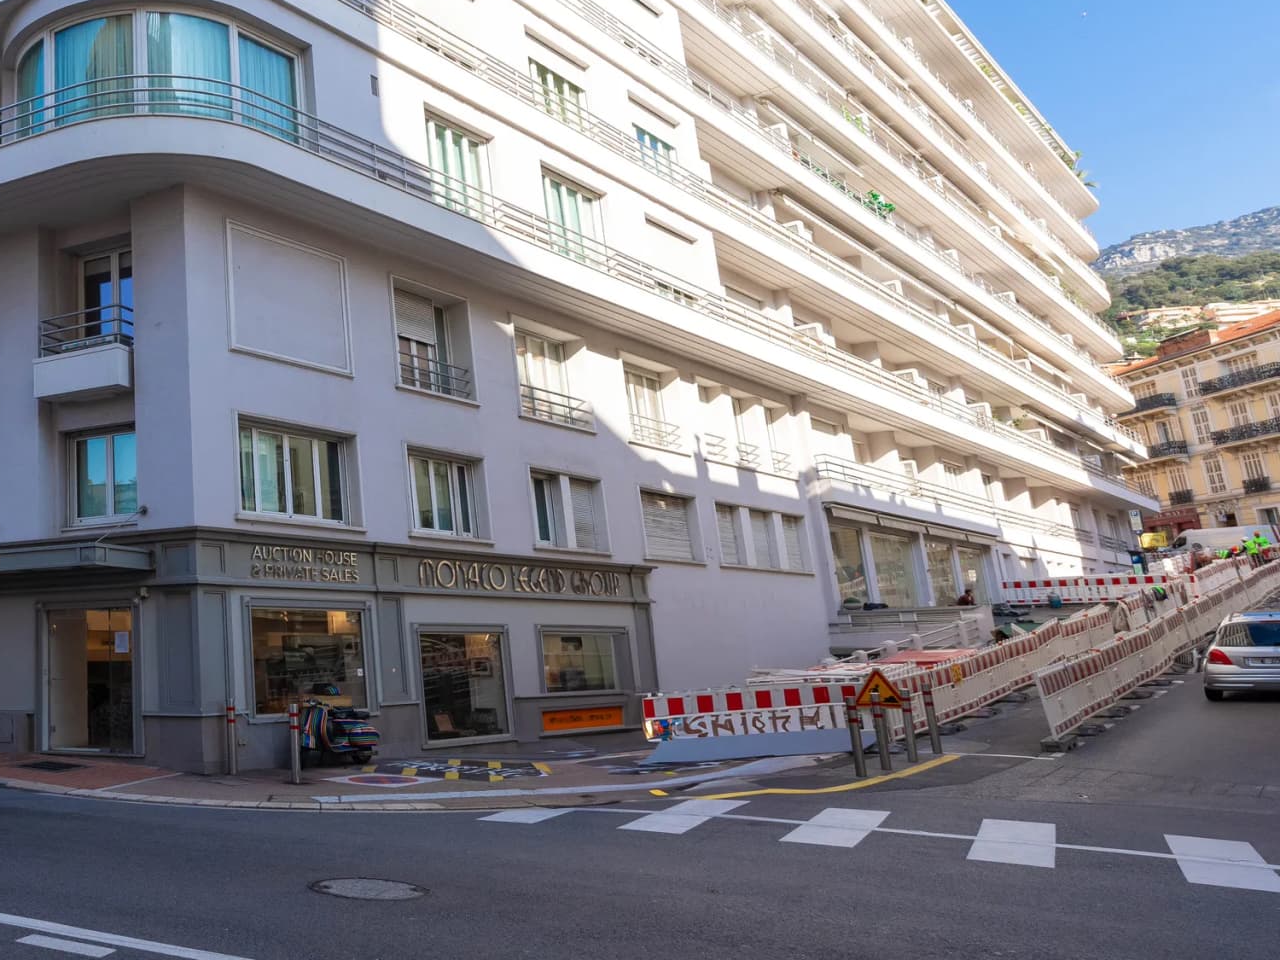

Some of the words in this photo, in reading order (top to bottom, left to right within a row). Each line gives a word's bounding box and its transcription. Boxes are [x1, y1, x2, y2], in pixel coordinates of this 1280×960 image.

[251, 545, 312, 563] AUCTION
[314, 550, 358, 566] HOUSE
[264, 564, 321, 581] PRIVATE
[321, 567, 360, 583] SALES
[419, 559, 507, 590] MONACO
[511, 565, 566, 594] LEGEND
[571, 571, 620, 597] GROUP
